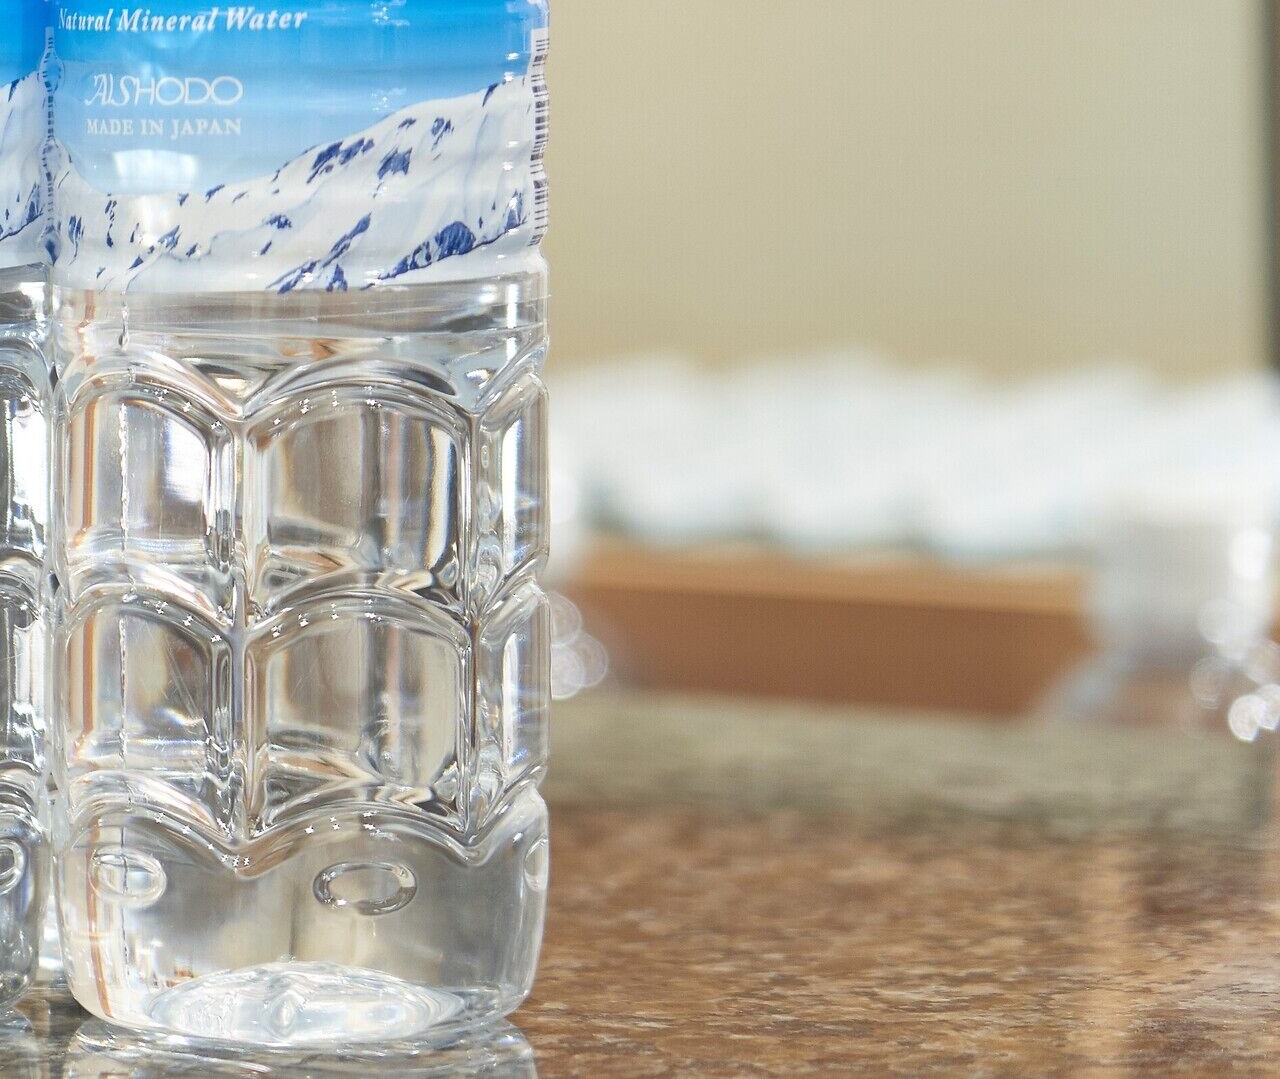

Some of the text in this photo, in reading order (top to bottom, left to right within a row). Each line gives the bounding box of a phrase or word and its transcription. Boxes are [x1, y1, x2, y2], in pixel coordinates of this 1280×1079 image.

[58, 6, 309, 33] Natural Mineral Water
[86, 118, 240, 141] MADE IN JAPAN
